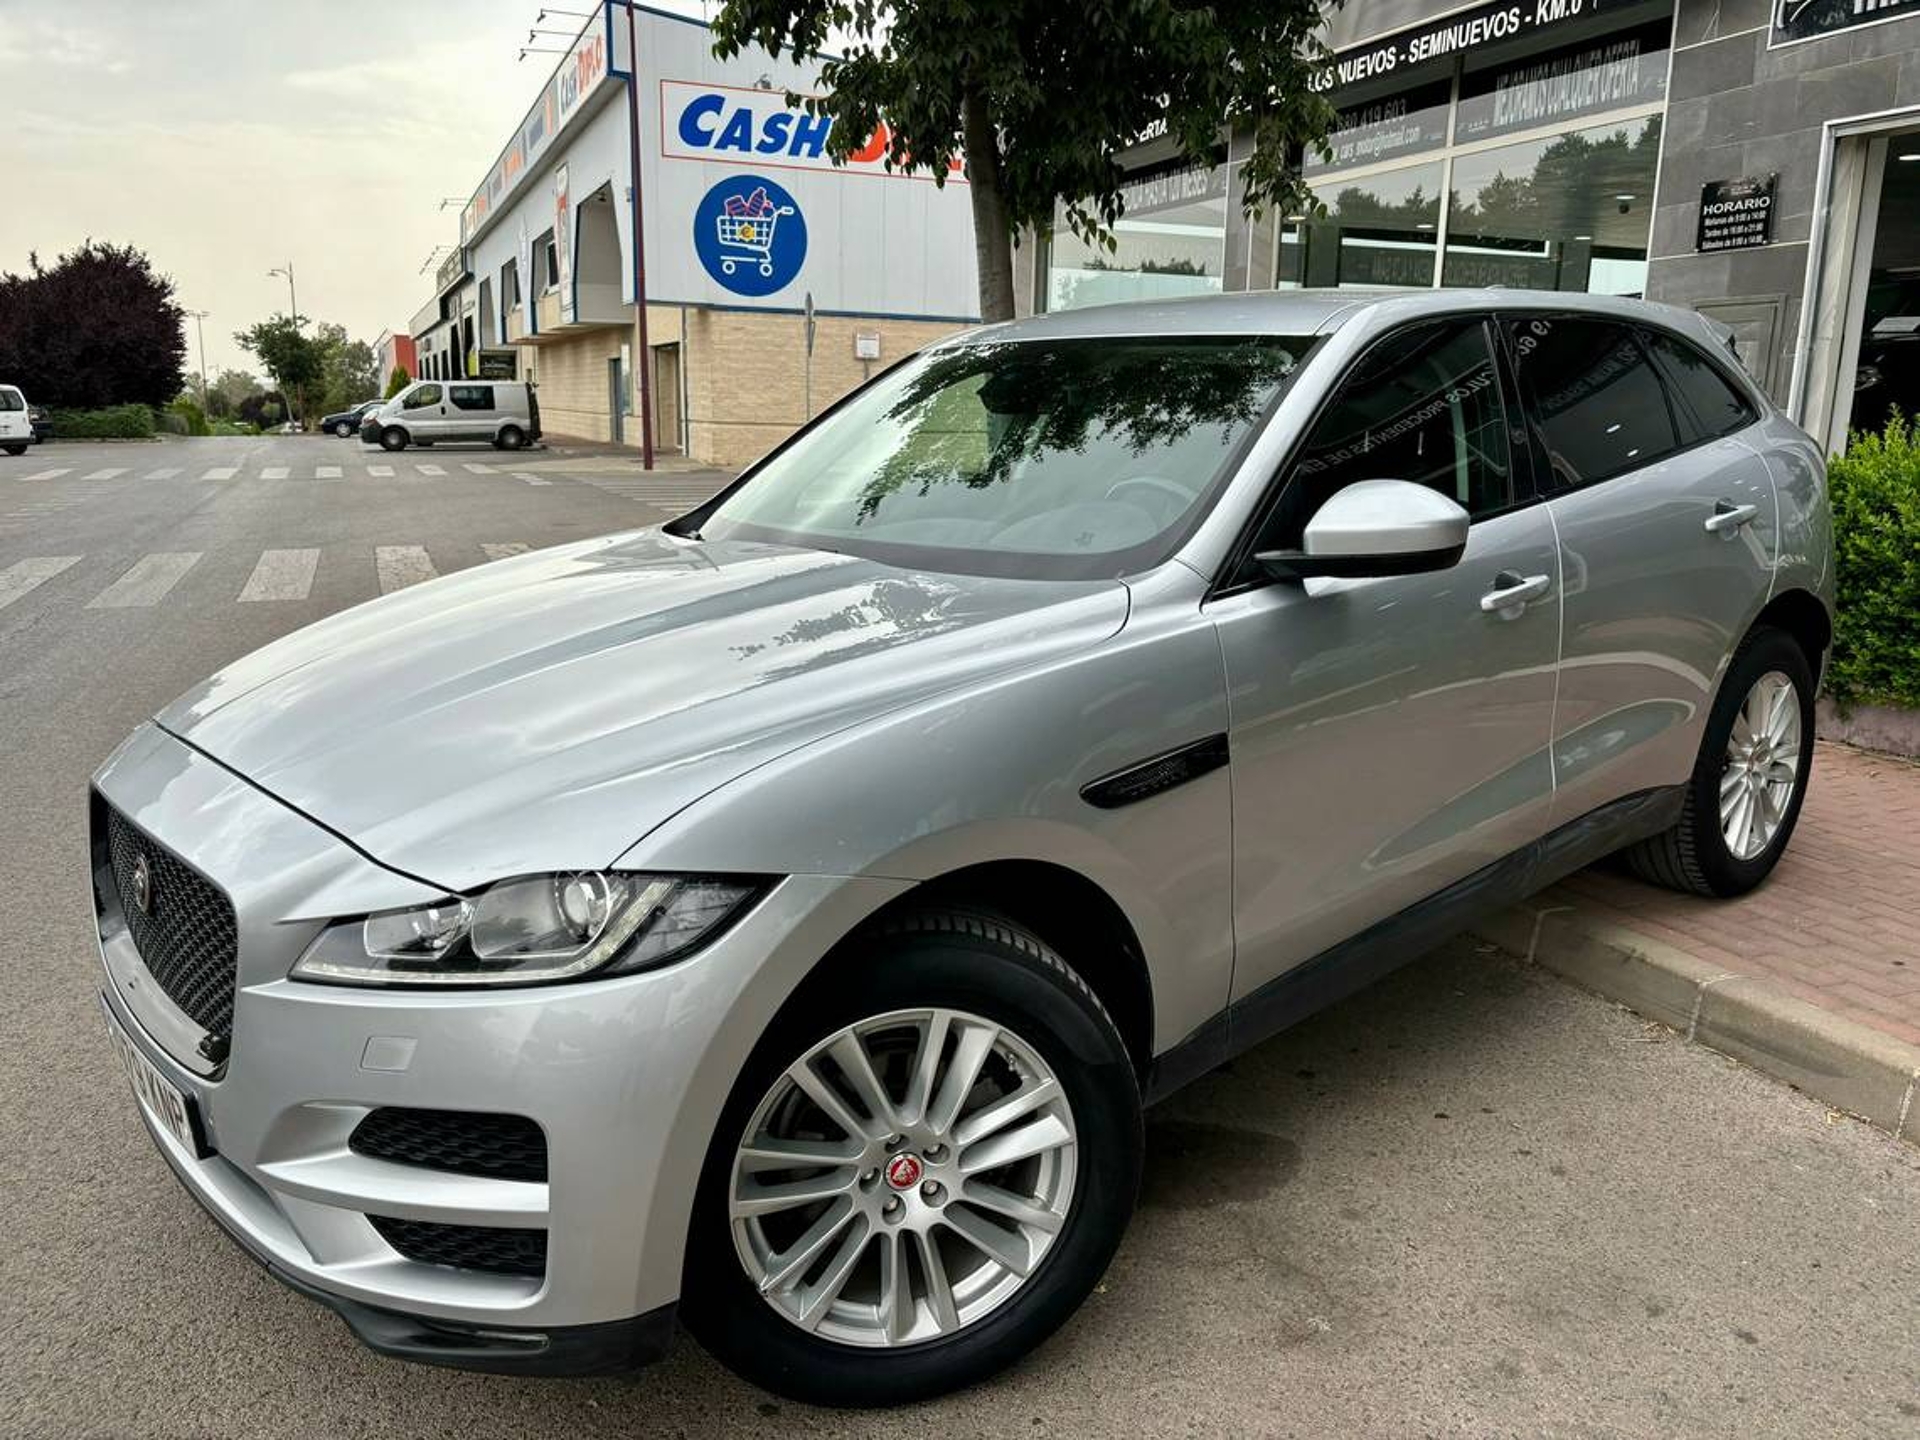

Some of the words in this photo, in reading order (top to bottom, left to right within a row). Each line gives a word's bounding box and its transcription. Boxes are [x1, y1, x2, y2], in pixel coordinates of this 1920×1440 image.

[1338, 46, 1397, 84] NUEVOS
[1408, 6, 1520, 64] SEMINUEVOS
[678, 94, 832, 158] CASH
[1703, 196, 1771, 215] HORARIO
